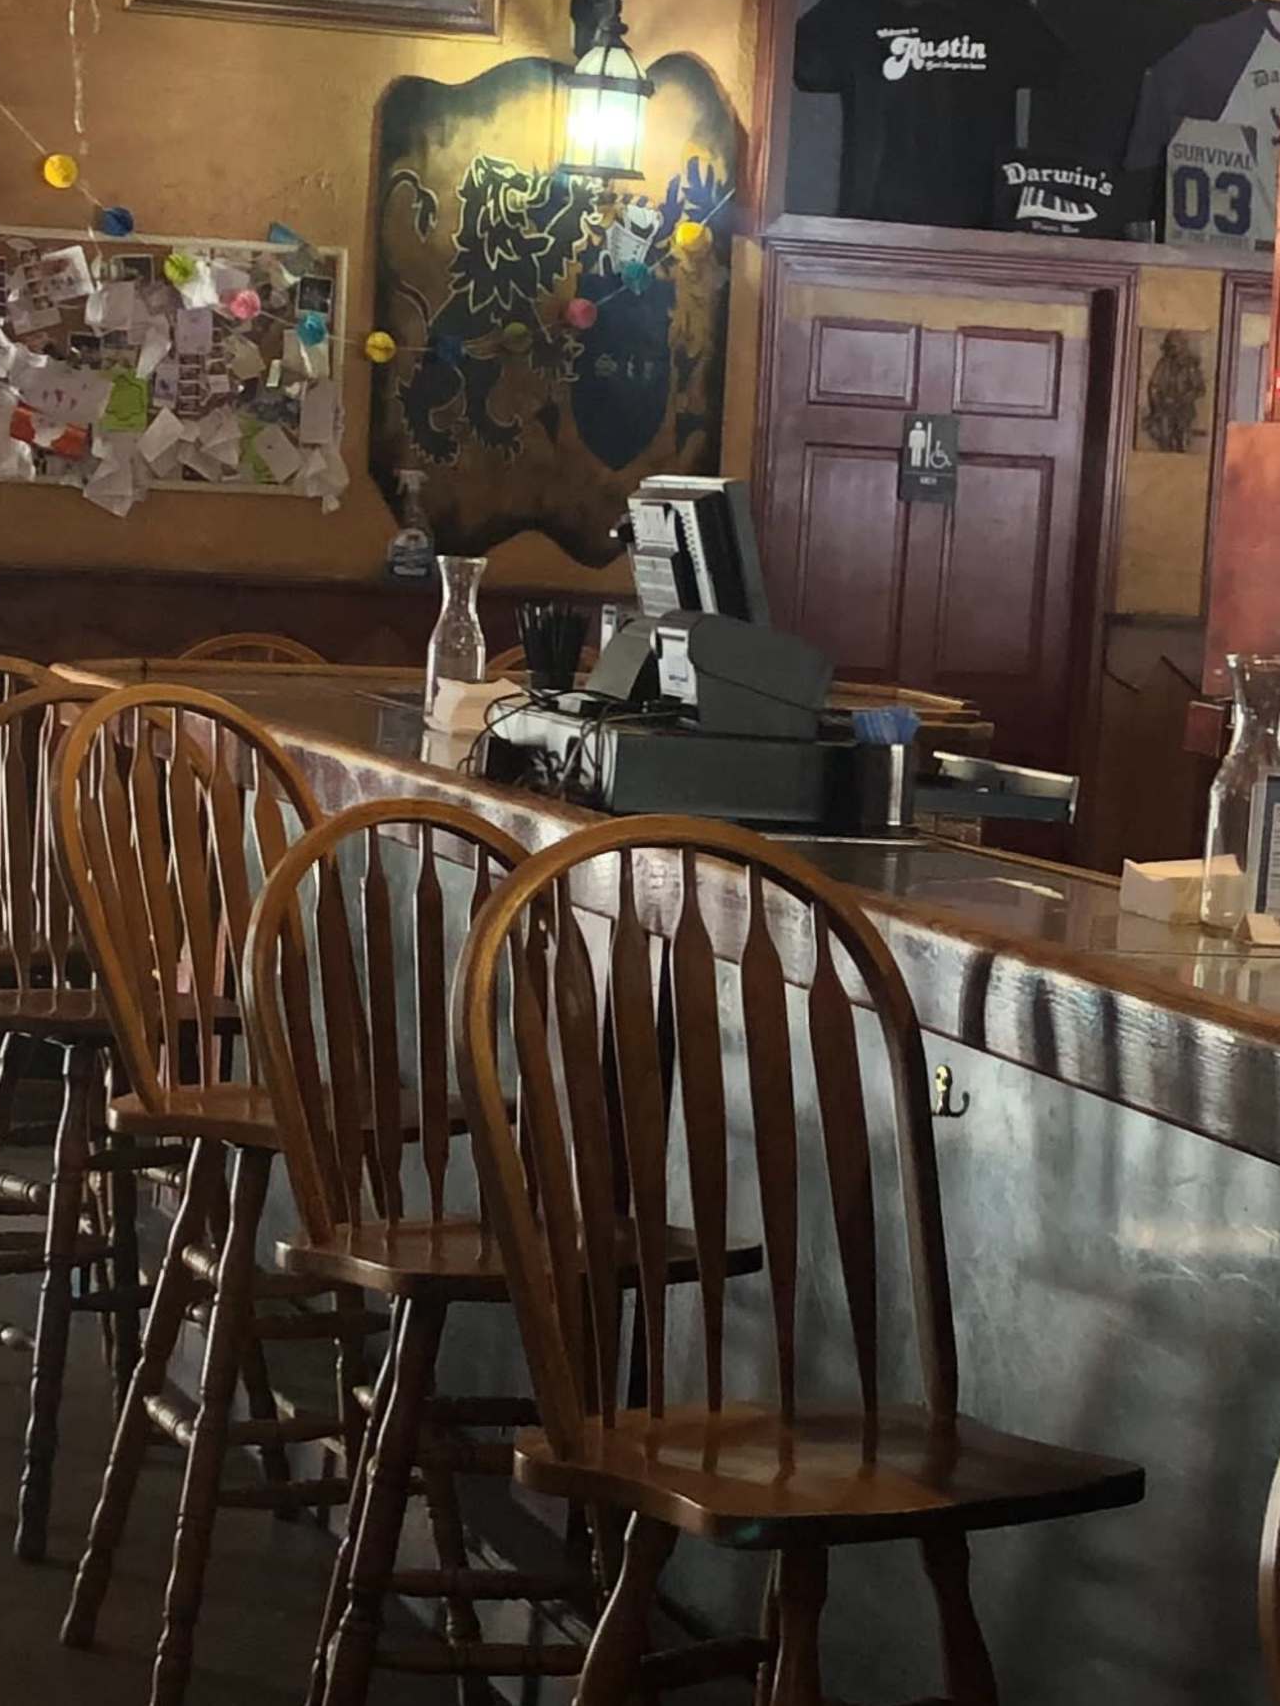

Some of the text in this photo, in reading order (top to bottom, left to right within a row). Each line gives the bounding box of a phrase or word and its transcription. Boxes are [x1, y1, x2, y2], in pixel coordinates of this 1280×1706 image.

[882, 34, 987, 81] Austin
[1172, 142, 1253, 171] SURVIVAL
[1001, 161, 1114, 197] Darwin's
[1173, 165, 1253, 236] 03
